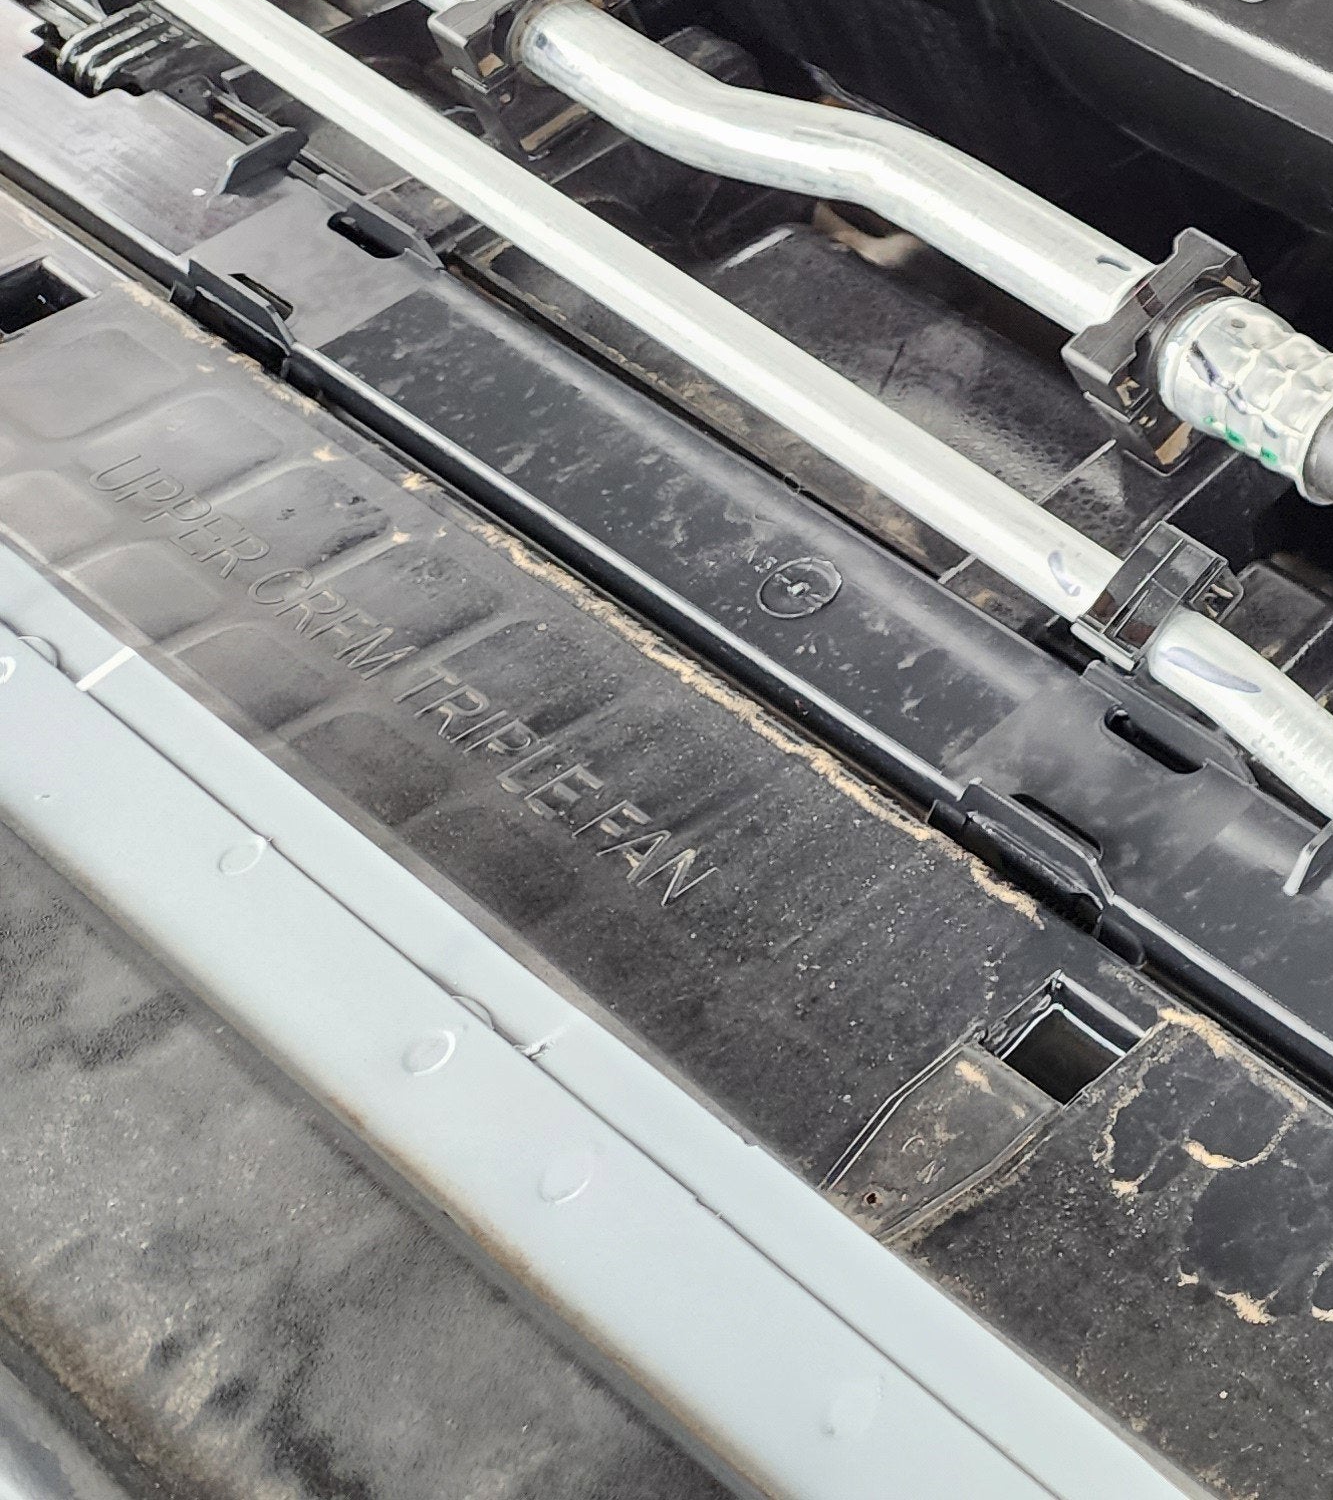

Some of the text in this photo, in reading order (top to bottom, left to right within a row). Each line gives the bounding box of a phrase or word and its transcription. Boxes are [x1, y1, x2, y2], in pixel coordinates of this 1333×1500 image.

[88, 453, 720, 907] UPPER CRFM TRIPLE FAN
